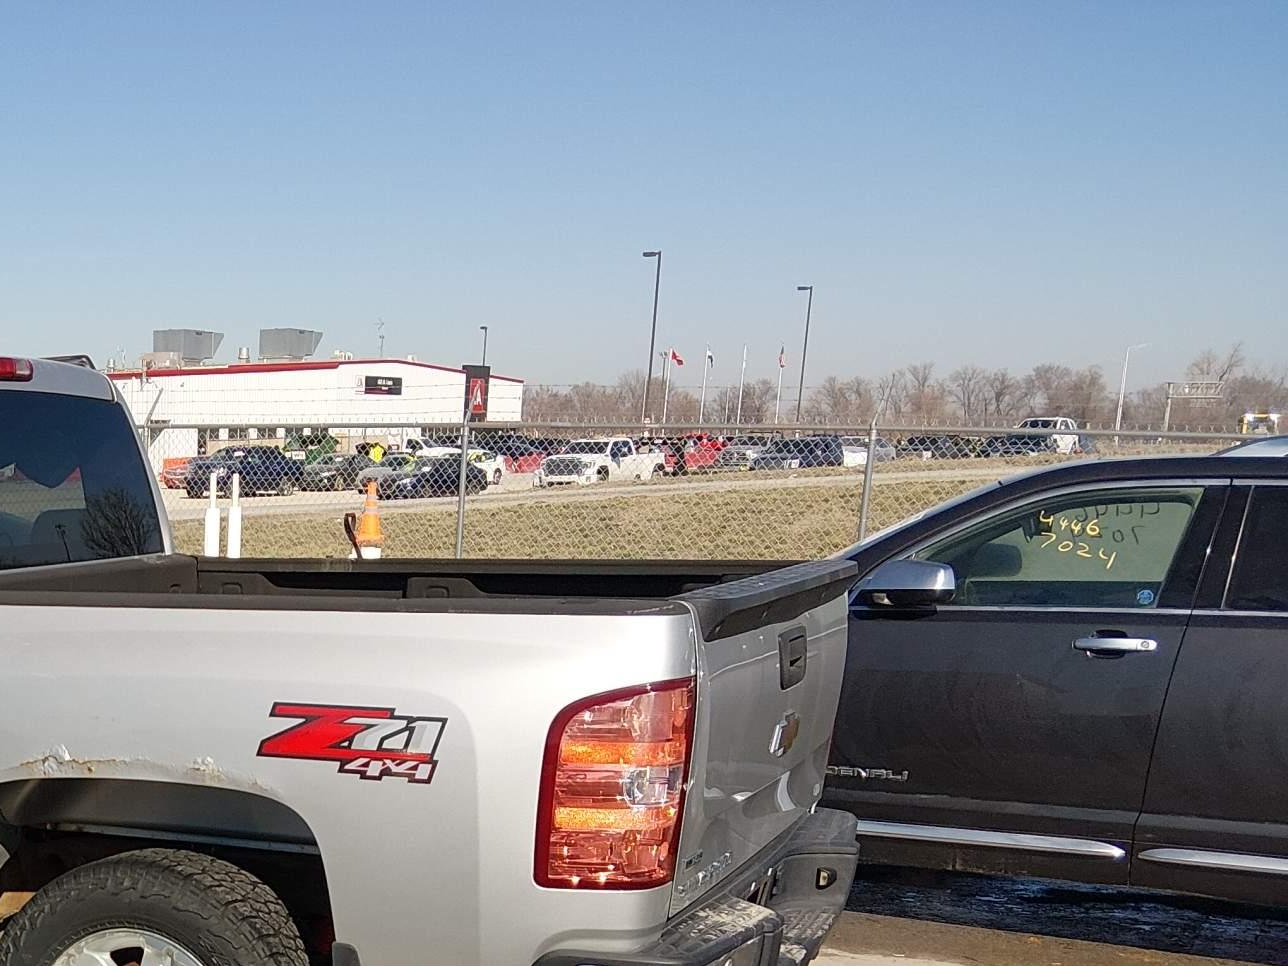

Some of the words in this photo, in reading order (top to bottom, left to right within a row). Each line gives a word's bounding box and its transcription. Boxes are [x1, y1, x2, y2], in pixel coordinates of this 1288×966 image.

[1039, 510, 1101, 537] 4446
[1040, 532, 1118, 570] 7024
[256, 701, 450, 762] Z71
[825, 765, 909, 782] DENALI
